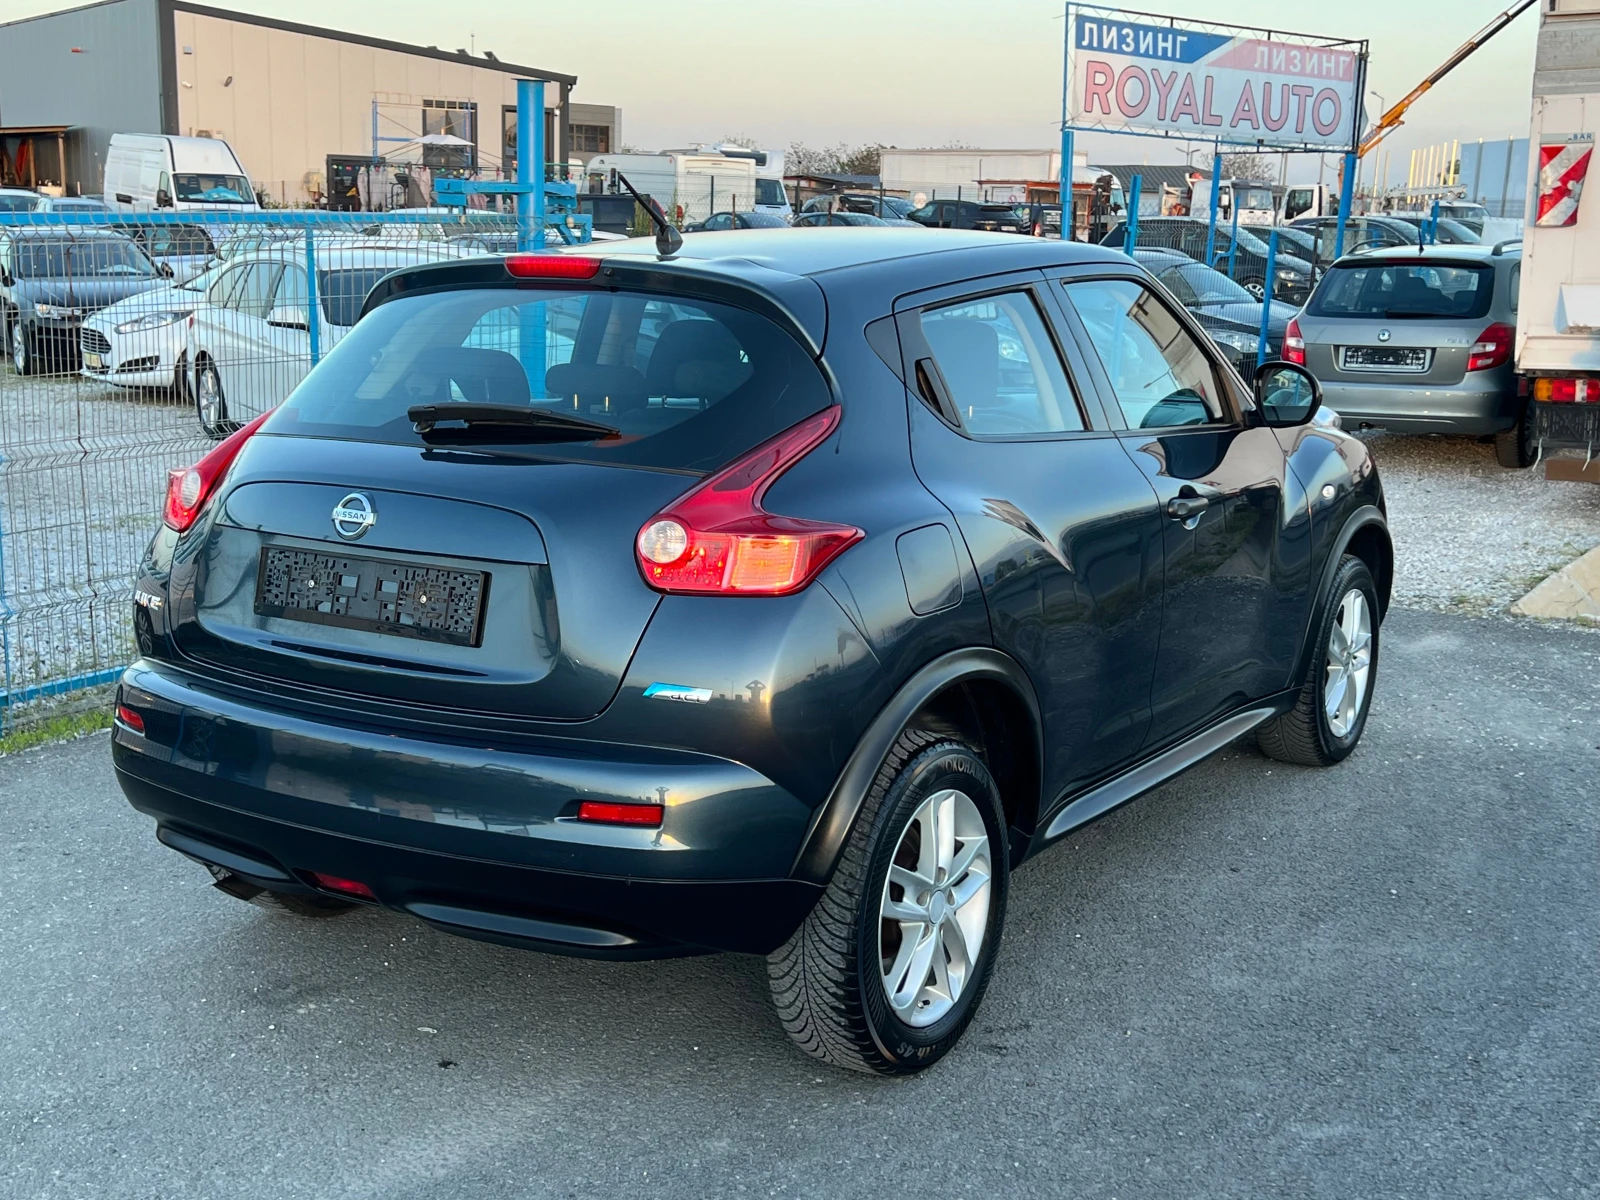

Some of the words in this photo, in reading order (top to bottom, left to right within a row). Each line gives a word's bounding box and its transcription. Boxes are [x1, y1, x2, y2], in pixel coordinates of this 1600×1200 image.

[1081, 21, 1188, 59] ЛИЗИНГ
[1254, 46, 1351, 79] ЛИЗИНГ
[1084, 60, 1222, 127] ROYAL
[1230, 79, 1342, 136] AUTO
[334, 510, 367, 521] NISSAN
